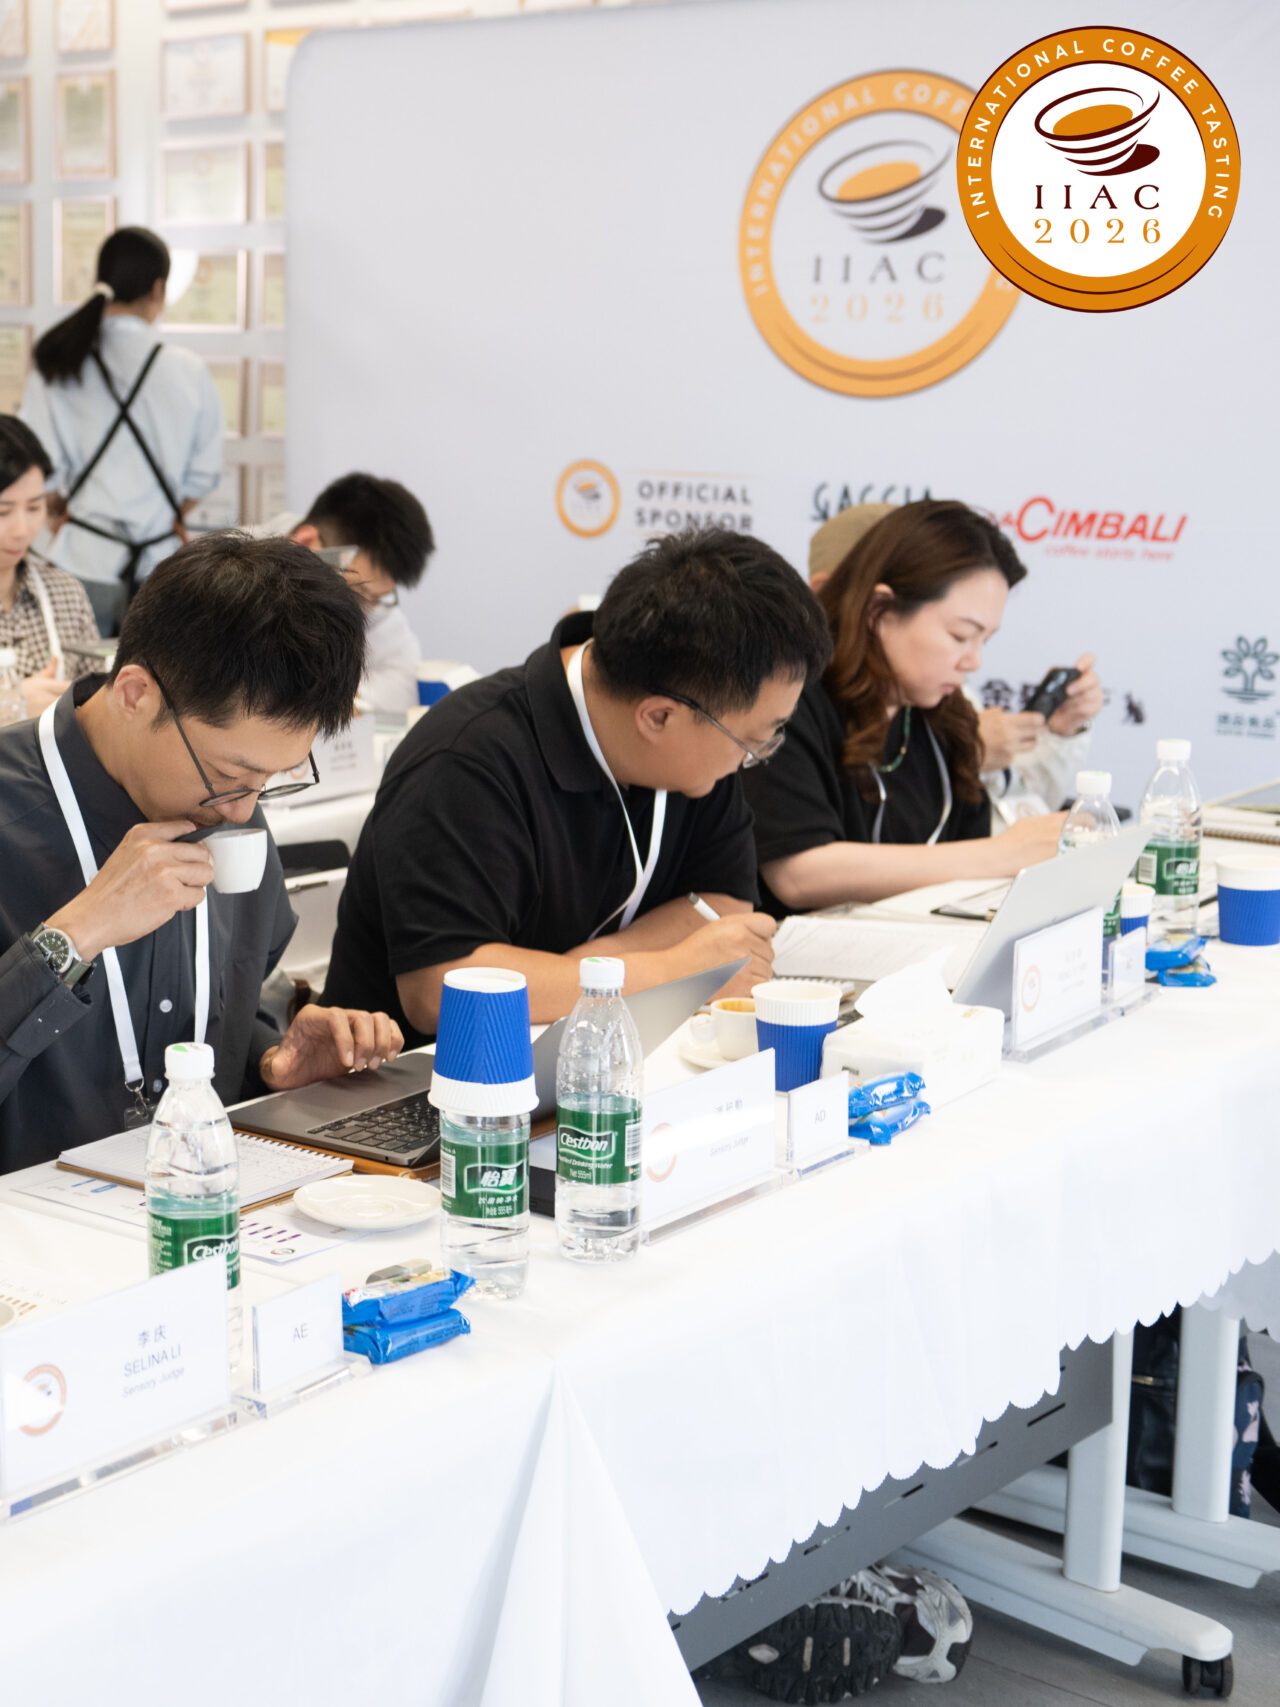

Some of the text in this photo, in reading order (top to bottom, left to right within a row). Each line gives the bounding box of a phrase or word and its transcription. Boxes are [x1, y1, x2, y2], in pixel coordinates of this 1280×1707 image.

[746, 80, 969, 296] INTERNATIONAL COFF
[811, 251, 946, 284] IIAC
[809, 293, 944, 323] 2026
[638, 479, 752, 507] OFFICIAL
[635, 507, 753, 533] SPONSOR
[1016, 496, 1188, 543] CIMBALI
[292, 1323, 309, 1344] AE
[123, 1343, 181, 1377] SELINA LI
[122, 1377, 157, 1398] Sensory
